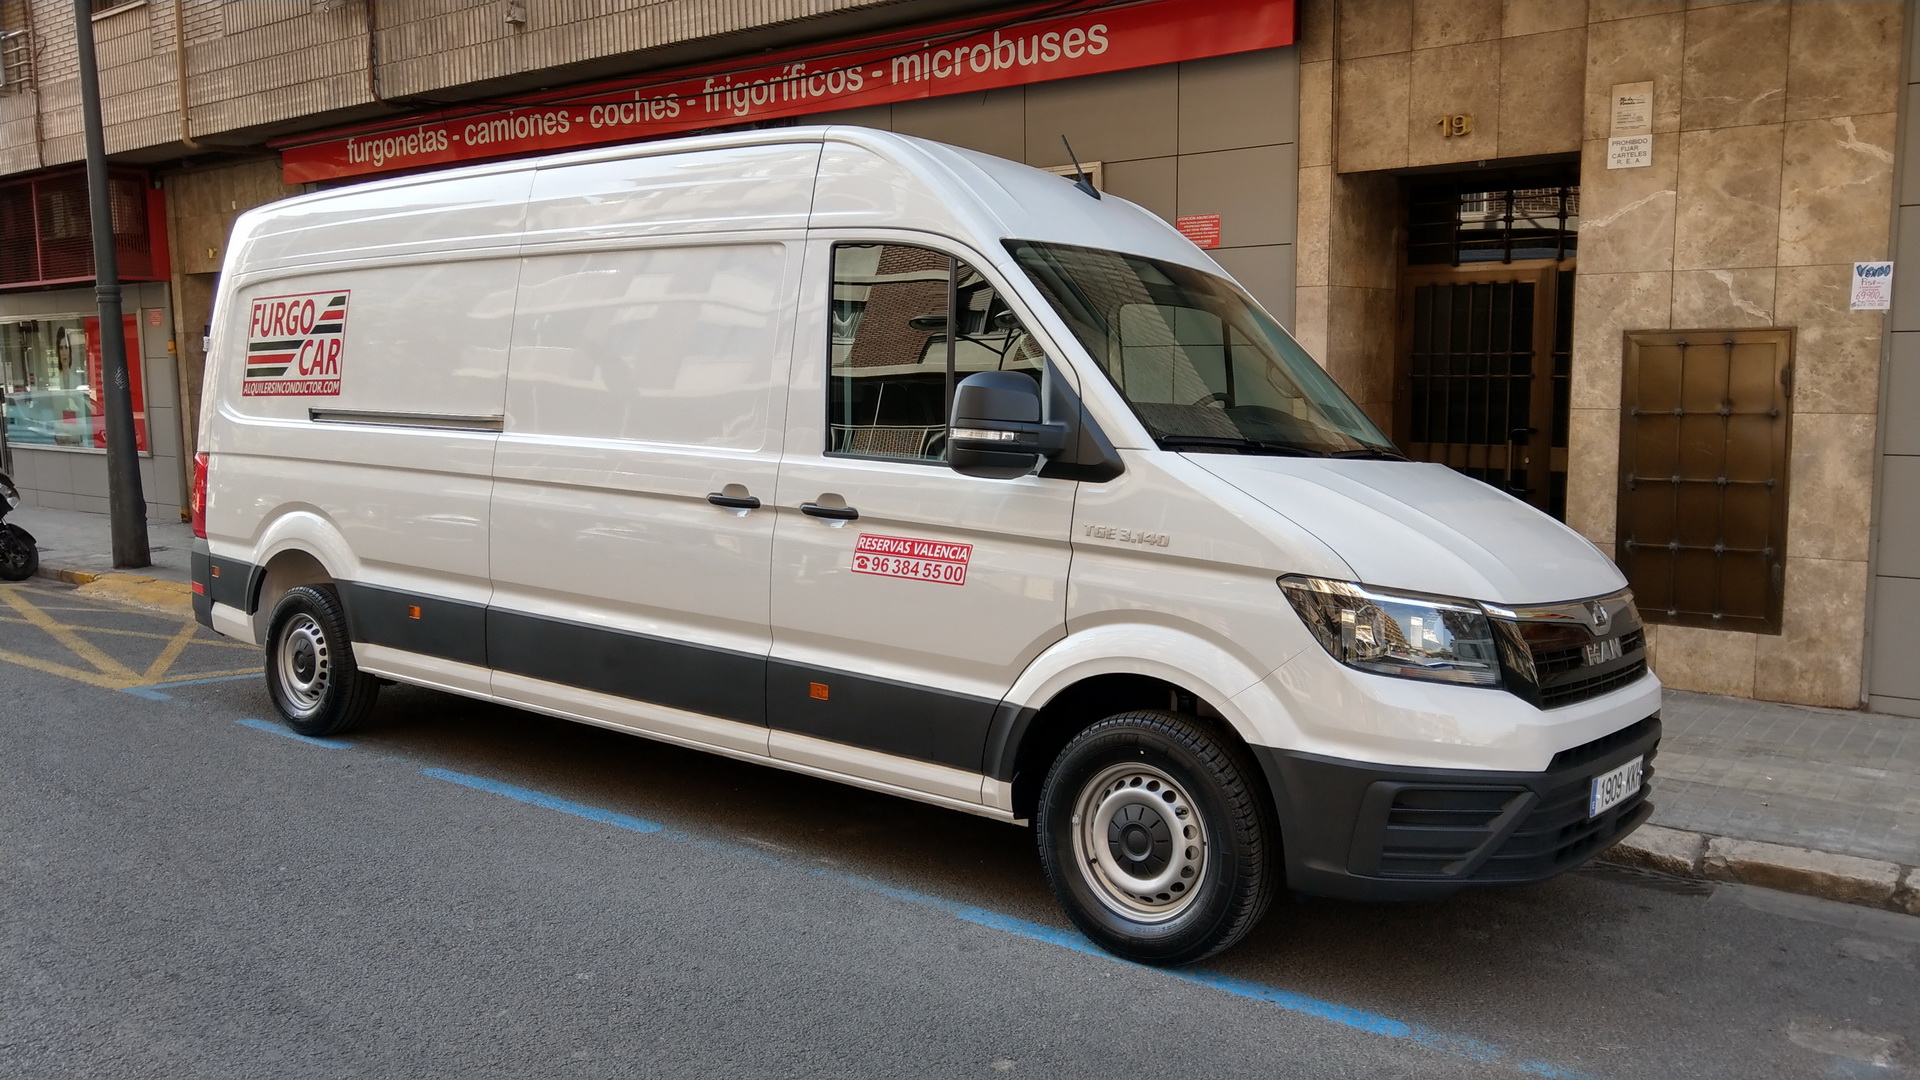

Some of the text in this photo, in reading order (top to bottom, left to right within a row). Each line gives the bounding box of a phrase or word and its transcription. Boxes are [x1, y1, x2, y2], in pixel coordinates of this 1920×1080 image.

[347, 126, 449, 167] furgonetas
[464, 110, 571, 146] camiones
[589, 91, 681, 129] coches
[703, 63, 864, 117] frigoríficos
[891, 23, 1110, 85] microbuses
[1436, 115, 1472, 137] 19
[1612, 138, 1648, 146] PROHIBIDO
[1612, 151, 1647, 159] CARTELES
[1856, 264, 1891, 277] VENDO
[251, 299, 315, 338] FURGO
[298, 338, 341, 376] CAR
[243, 381, 340, 395] ALQUILERSINCONDUCTOR.COM
[1084, 524, 1171, 548] TGE 3.140
[858, 537, 969, 560] RESERVAS VALENCIA
[871, 556, 963, 581] 96 384 55 00
[1586, 637, 1622, 667] MAN
[1601, 772, 1623, 808] 1909
